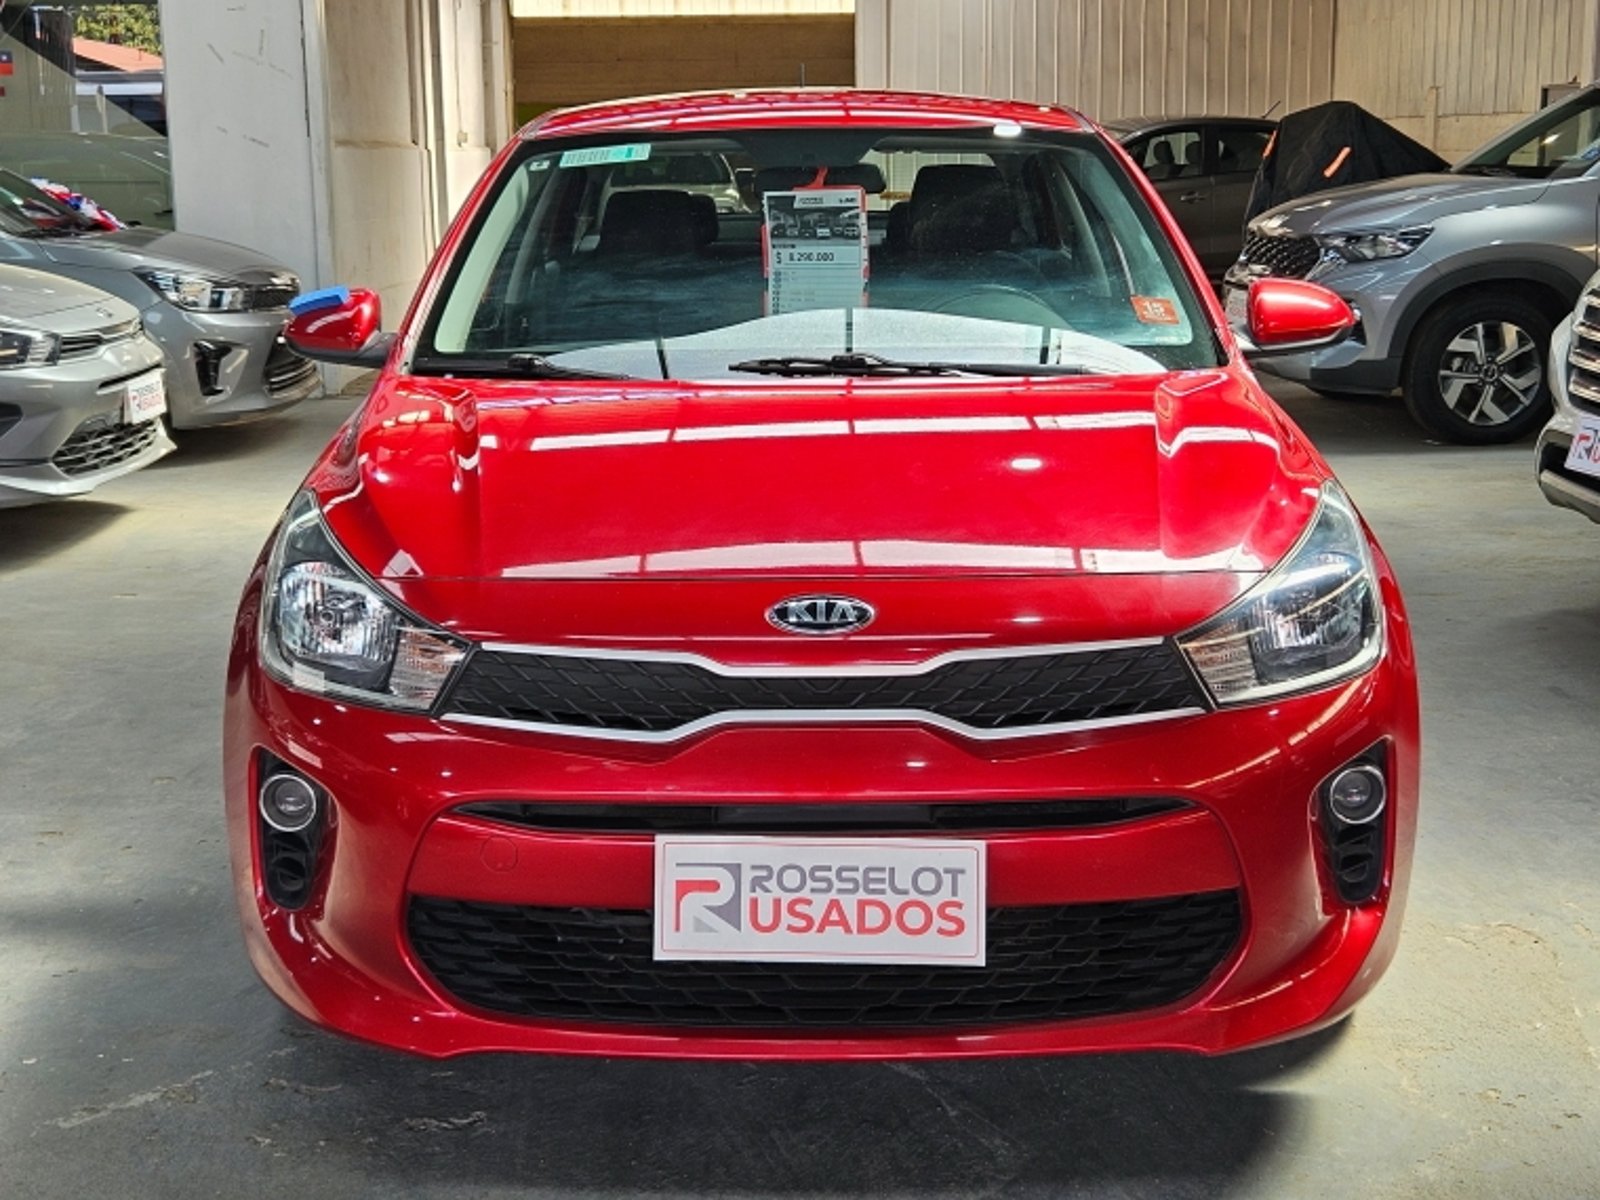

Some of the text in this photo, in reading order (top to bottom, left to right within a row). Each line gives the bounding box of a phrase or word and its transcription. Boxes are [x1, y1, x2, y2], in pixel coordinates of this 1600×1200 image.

[786, 599, 858, 623] KIA
[749, 863, 967, 897] ROSSELOT
[748, 897, 967, 937] USADOS
